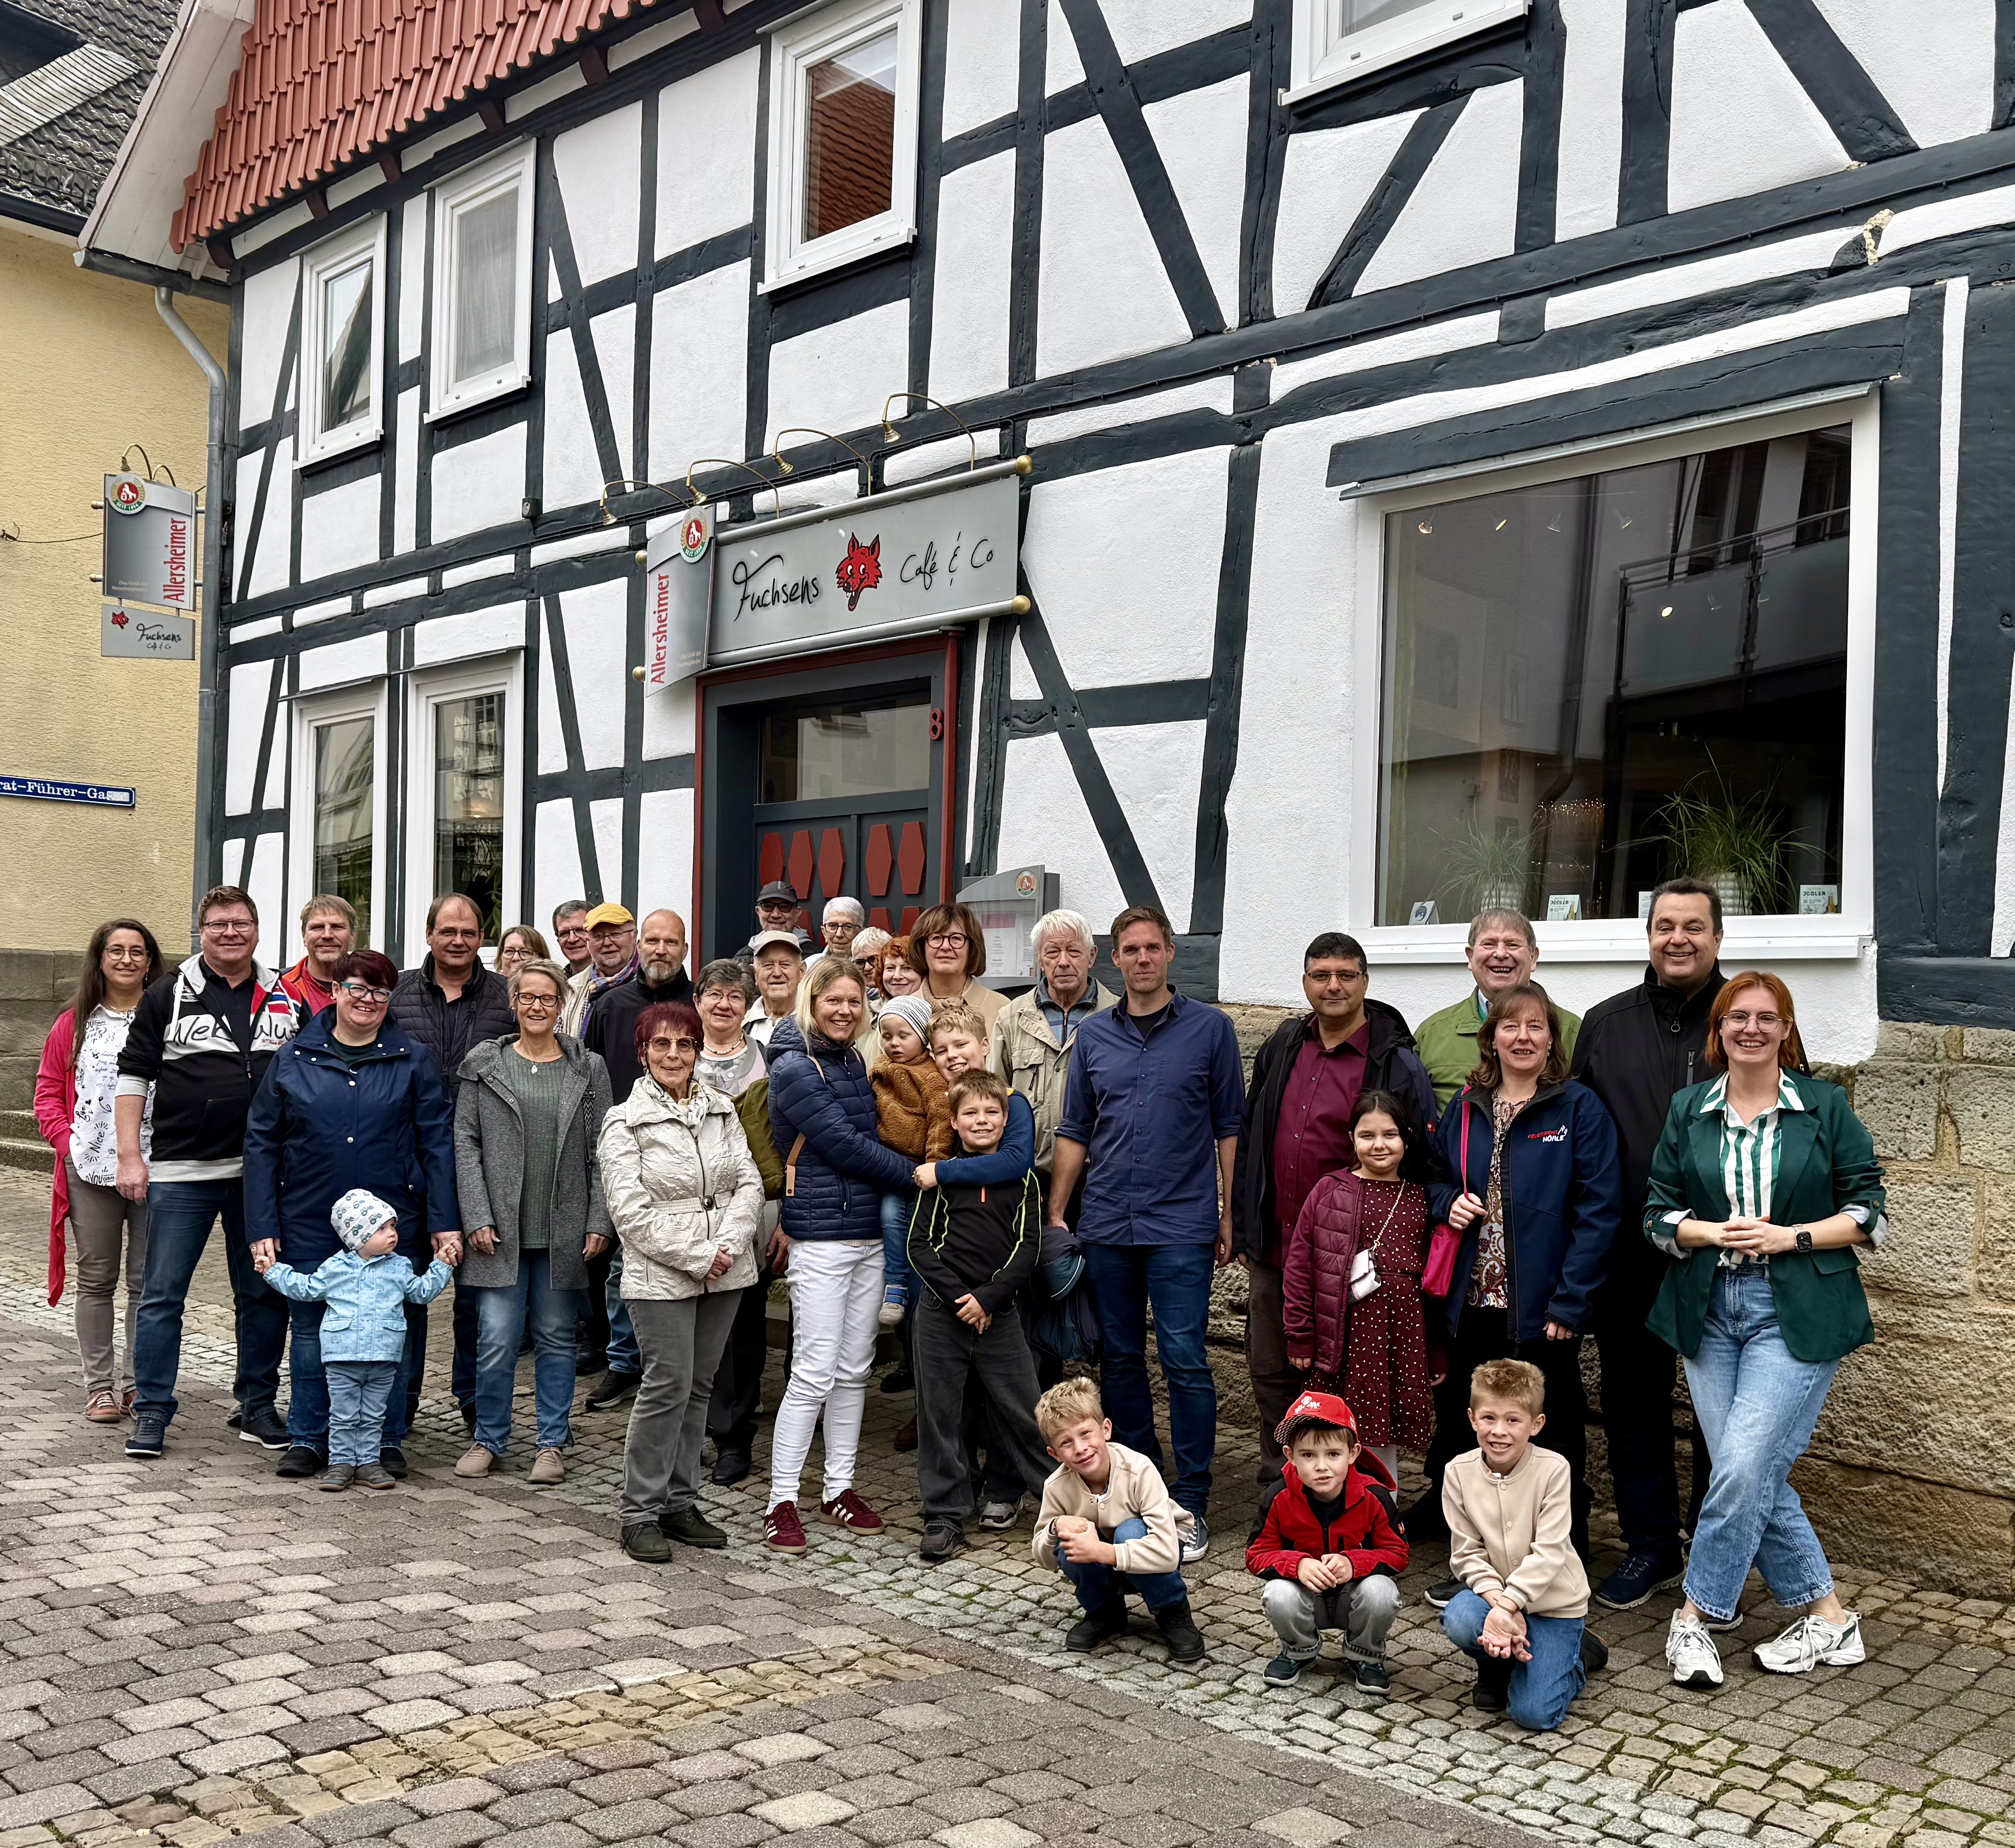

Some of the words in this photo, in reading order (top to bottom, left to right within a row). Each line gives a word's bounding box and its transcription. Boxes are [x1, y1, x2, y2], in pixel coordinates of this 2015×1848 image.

[163, 517, 186, 603] Allersheimer
[900, 541, 939, 591] Café
[971, 539, 993, 568] Co
[732, 554, 819, 622] Fuchsens
[136, 624, 181, 643] Fuchsens
[651, 573, 670, 684] Allersheimer
[929, 708, 943, 741] 8
[0, 780, 114, 801] at-Führer-Gas
[88, 1131, 105, 1153] Nice
